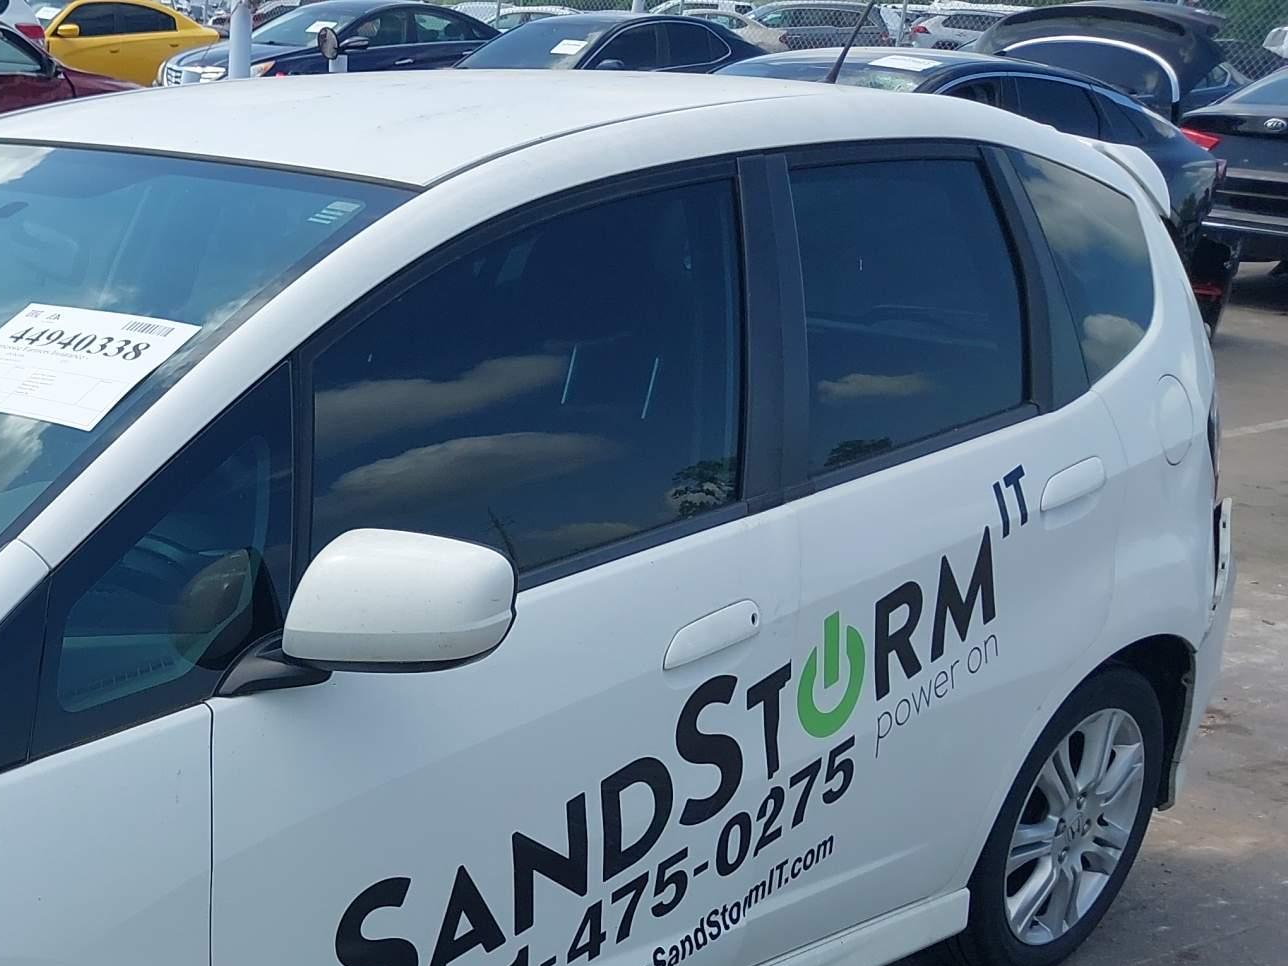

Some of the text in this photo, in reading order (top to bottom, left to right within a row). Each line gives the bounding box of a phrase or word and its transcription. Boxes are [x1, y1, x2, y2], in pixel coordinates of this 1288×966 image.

[9, 326, 151, 361] 44940338
[992, 465, 1026, 538] IT
[875, 634, 998, 758] power on
